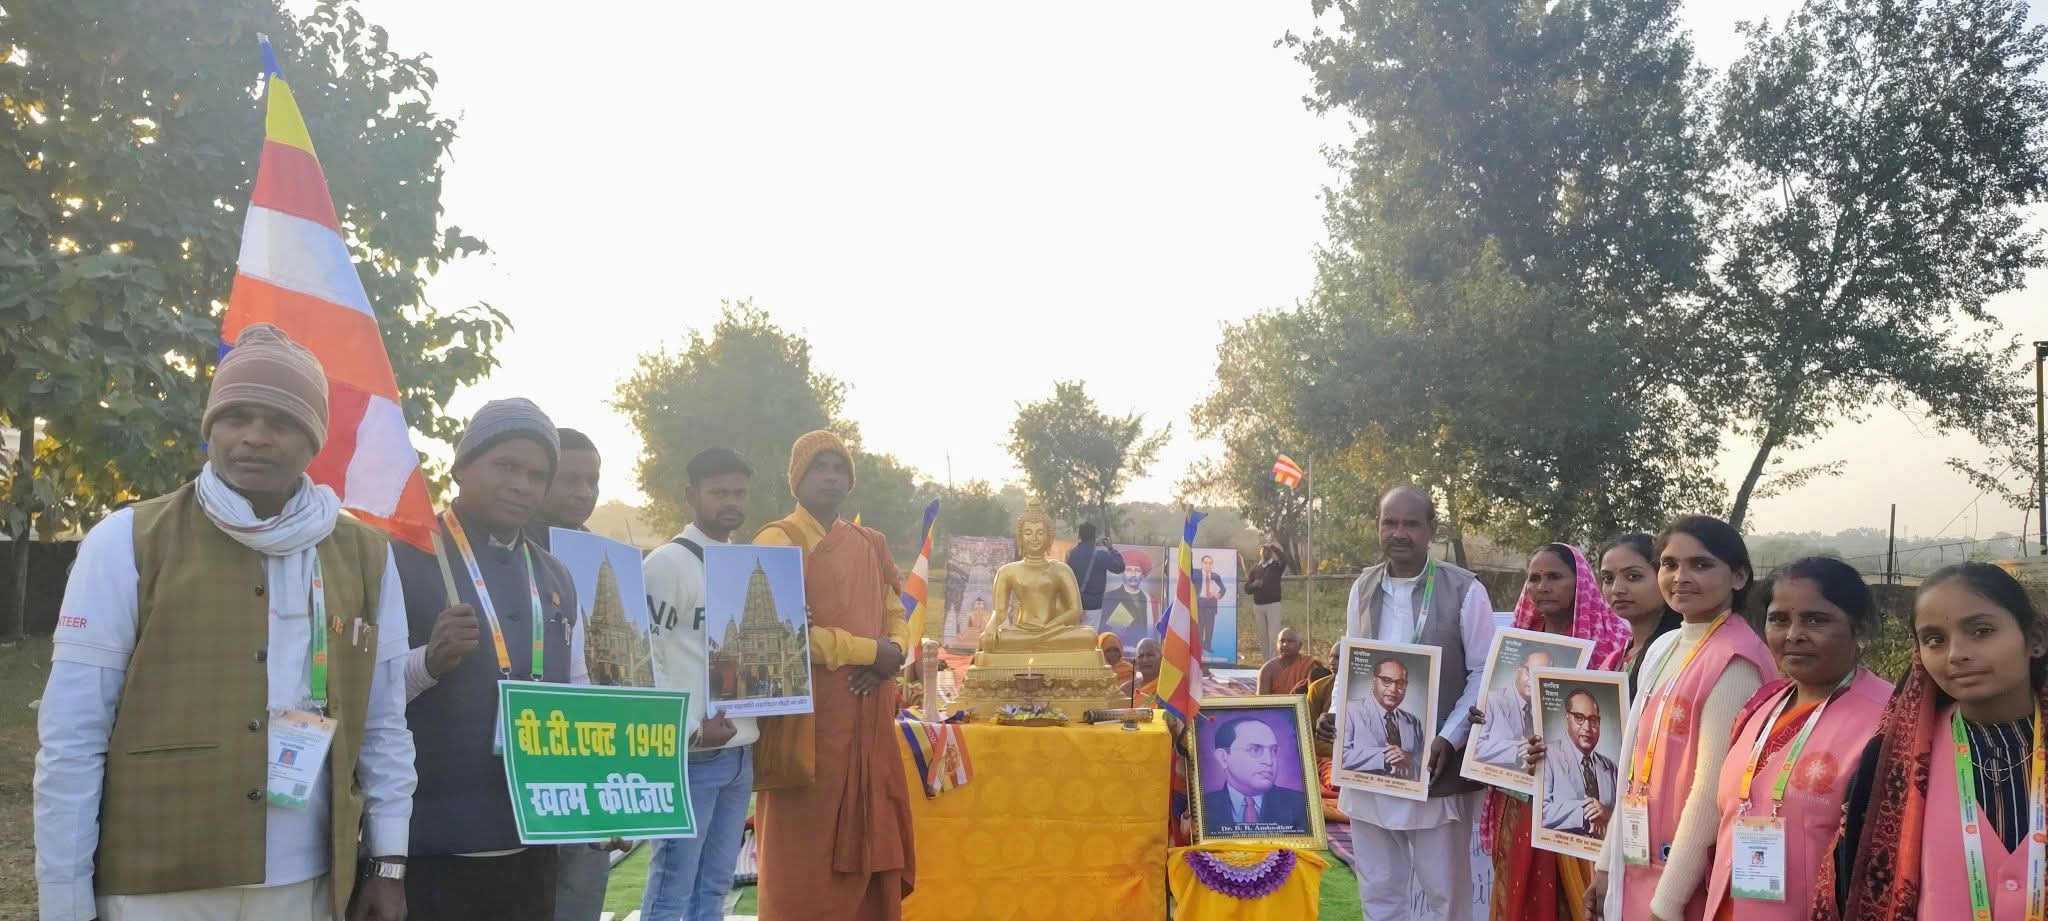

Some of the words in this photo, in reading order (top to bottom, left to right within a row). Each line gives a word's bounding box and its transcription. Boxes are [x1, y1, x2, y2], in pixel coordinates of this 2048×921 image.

[625, 723, 676, 757] 1949
[525, 782, 590, 816] खत्म
[594, 773, 675, 815] कीजिए
